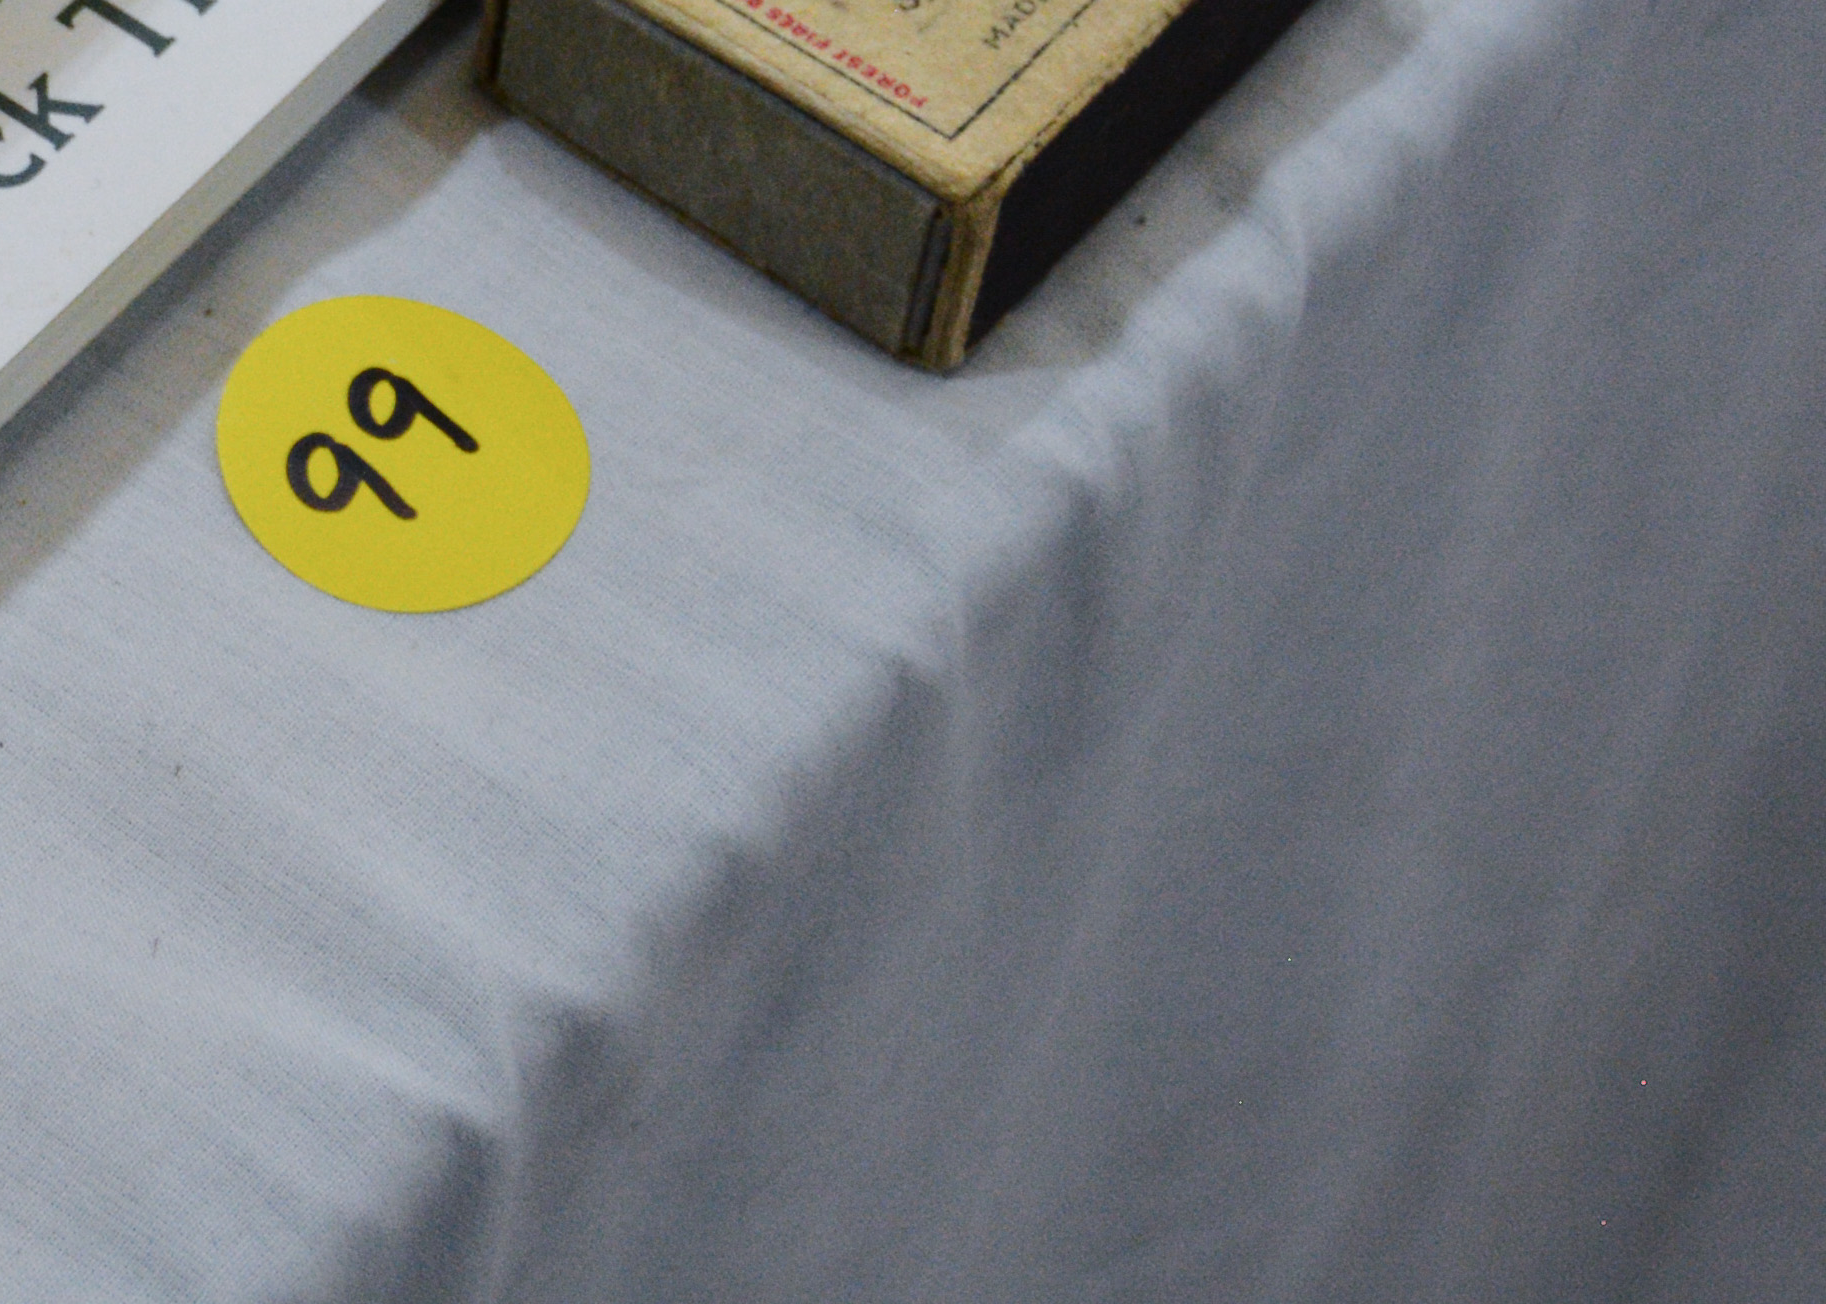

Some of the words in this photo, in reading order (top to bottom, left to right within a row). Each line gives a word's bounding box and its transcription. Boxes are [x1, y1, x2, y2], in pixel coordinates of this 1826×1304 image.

[764, 4, 832, 52] FIRES
[832, 47, 931, 109] FOREST
[282, 364, 483, 524] 99
